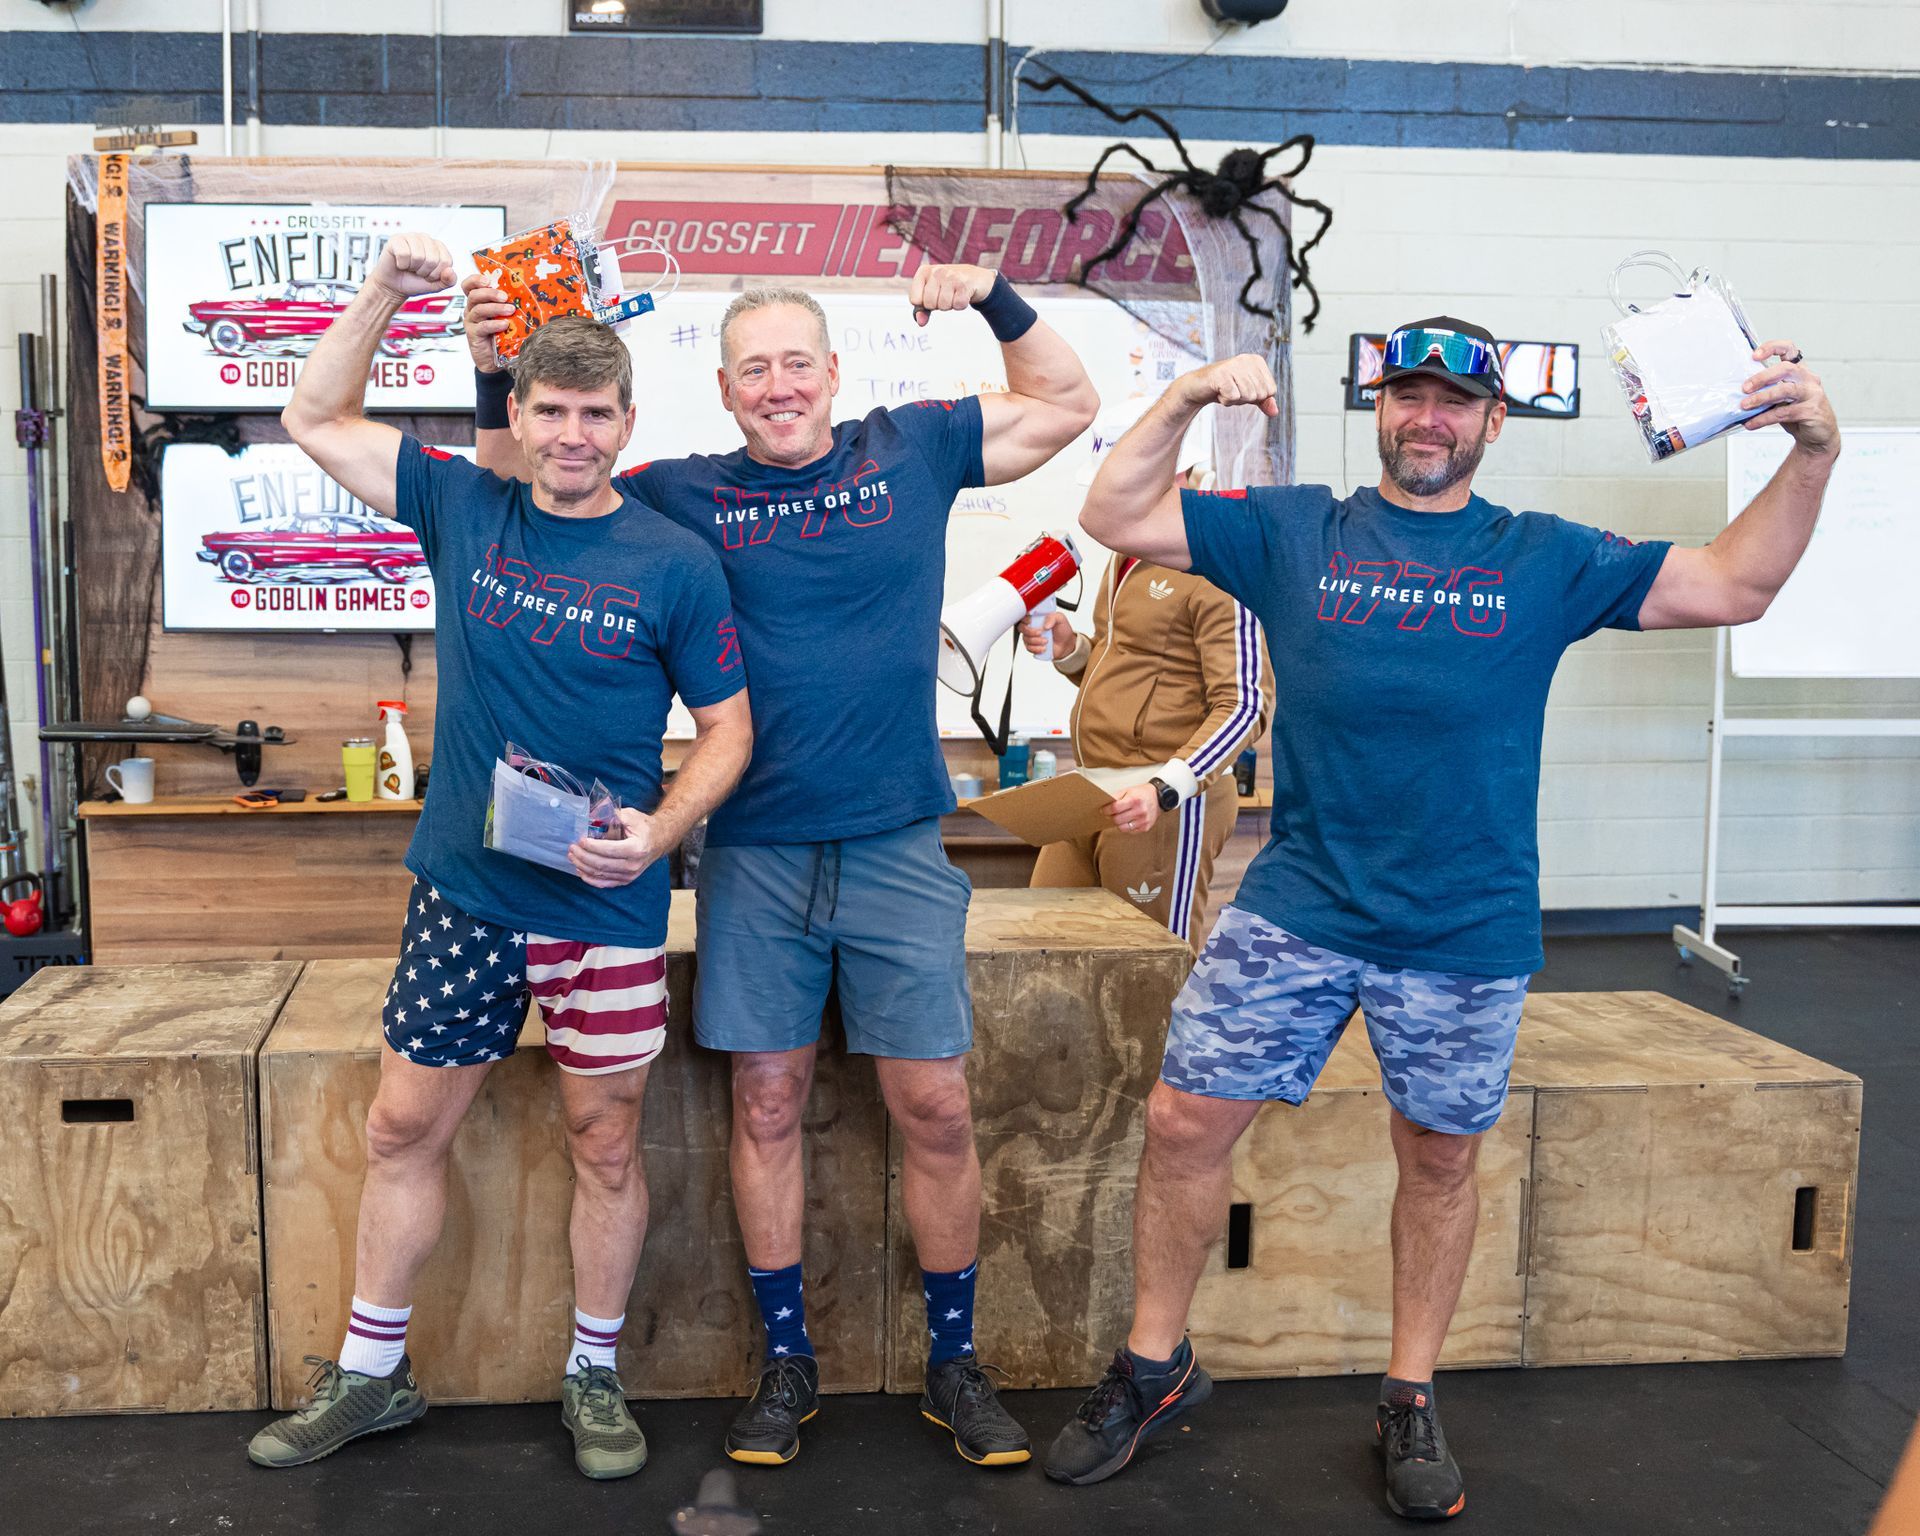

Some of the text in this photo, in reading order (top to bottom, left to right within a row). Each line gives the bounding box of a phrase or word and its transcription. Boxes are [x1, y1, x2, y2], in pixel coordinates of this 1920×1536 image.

[575, 13, 624, 23] ROGUE
[287, 215, 366, 229] CROSSFIT
[625, 204, 1197, 285] CROSSFIT ENFORCE
[104, 222, 120, 311] WARNING!
[844, 327, 932, 354] DIANE
[105, 354, 124, 444] WARNING!
[856, 378, 930, 399] TIME
[715, 480, 888, 525] LIVE FREE OR DIE
[255, 587, 327, 611] GOBLIN
[336, 587, 405, 611] GAMES
[472, 569, 636, 633] LIVE FREE OR DIE
[1319, 576, 1506, 610] LIVE FREE OR DIE
